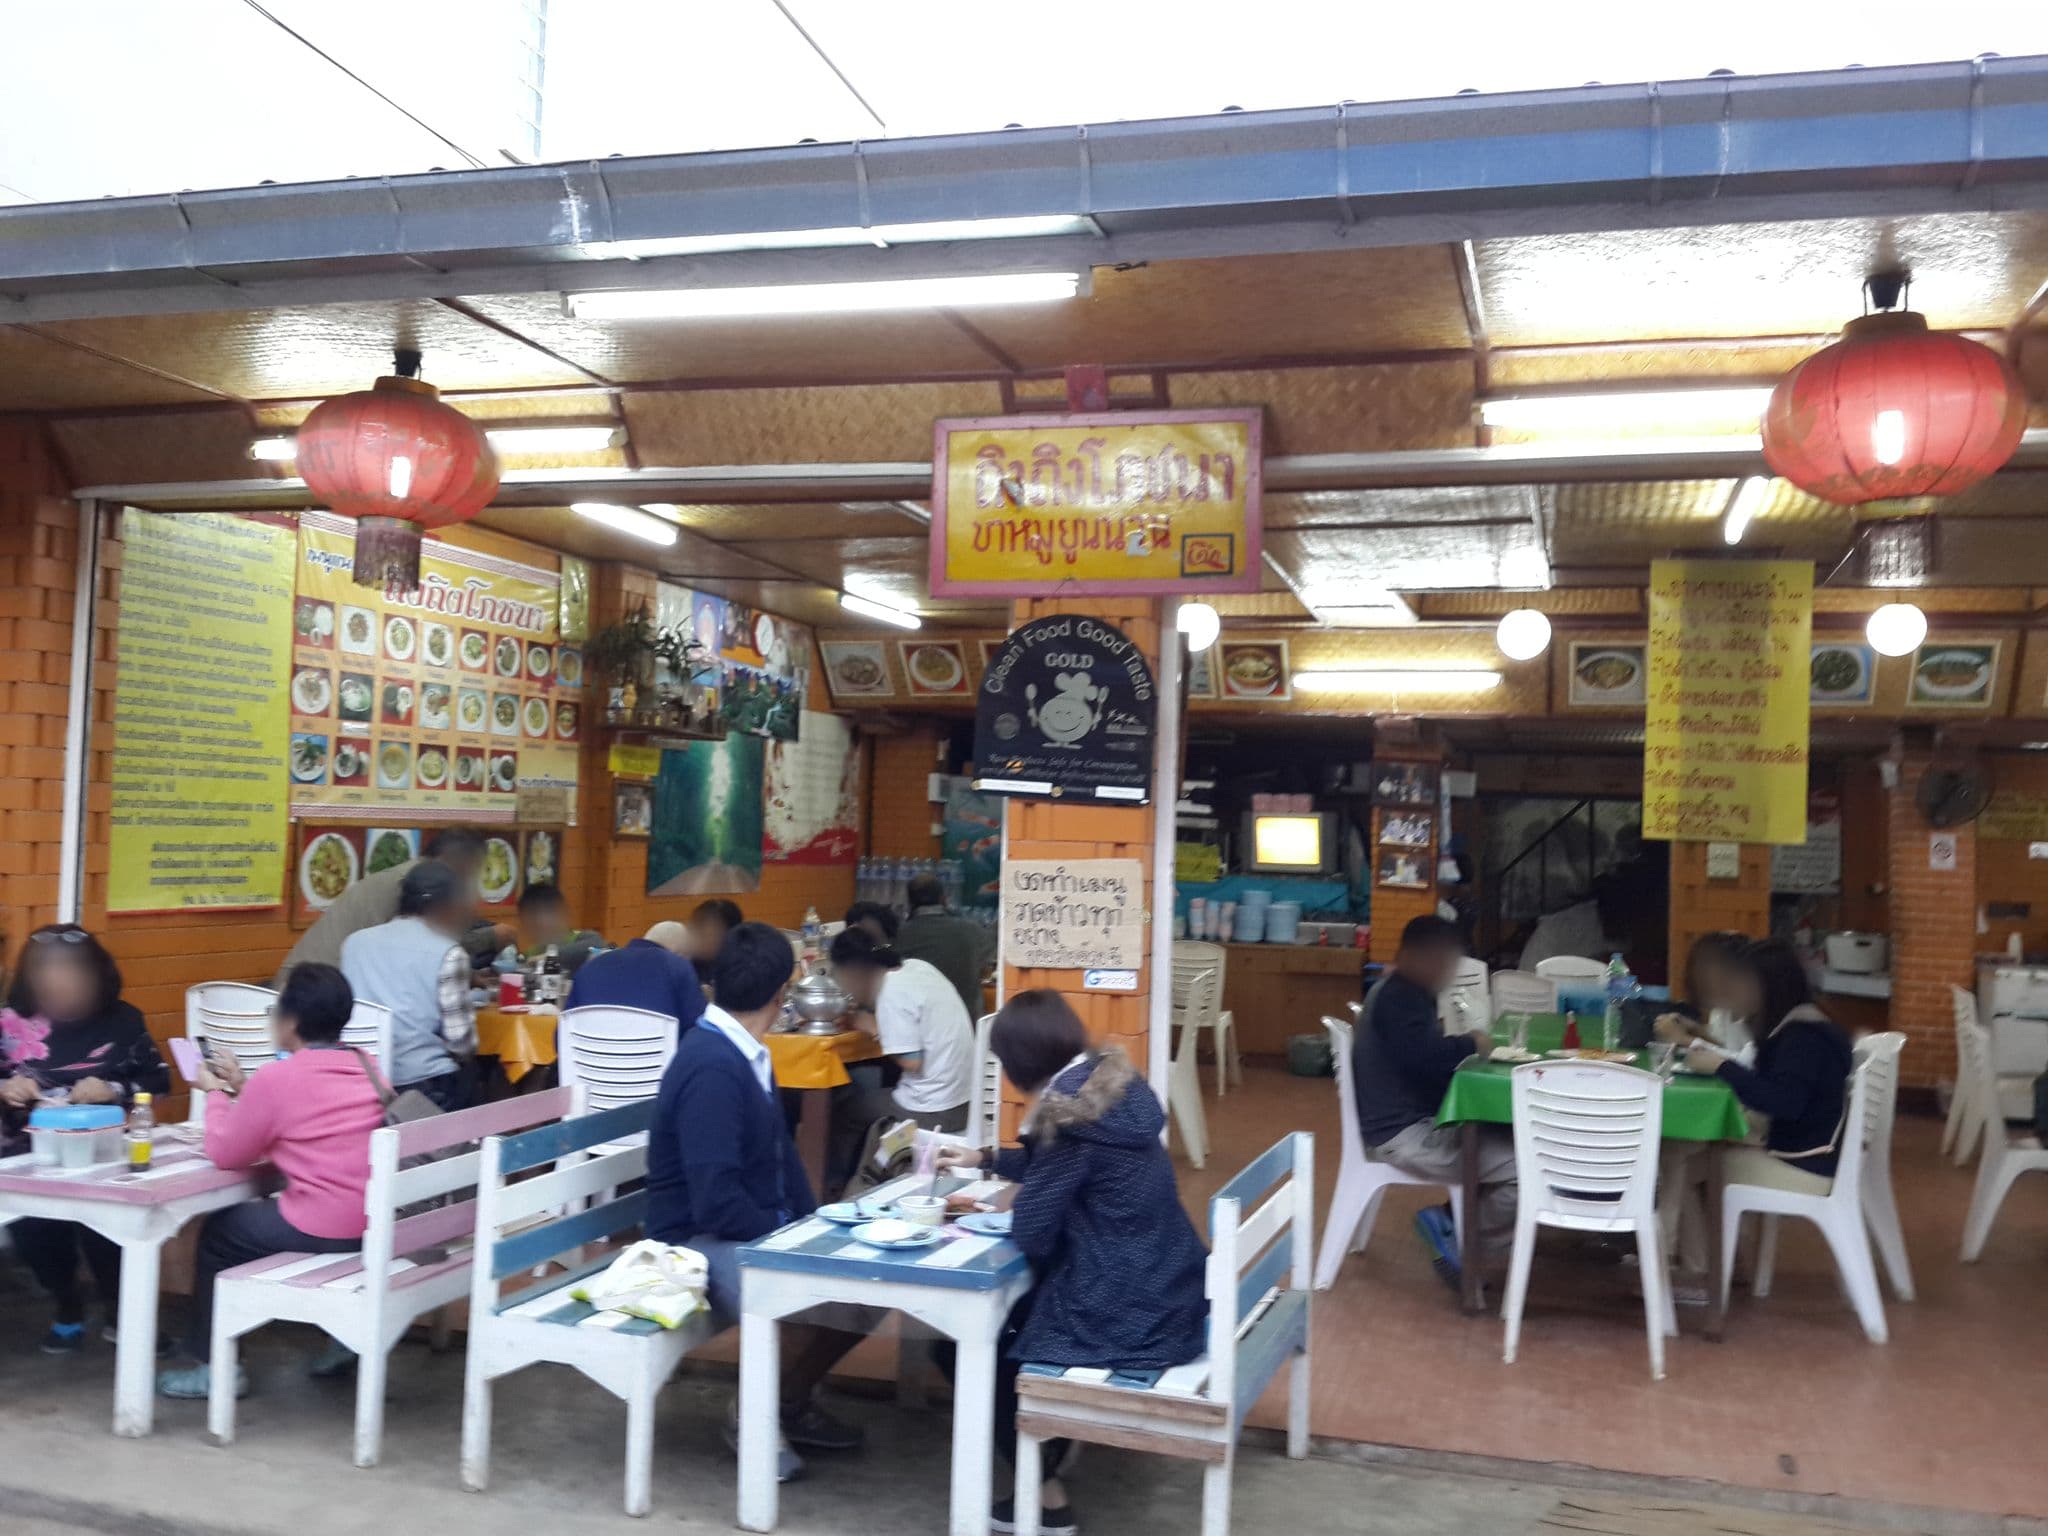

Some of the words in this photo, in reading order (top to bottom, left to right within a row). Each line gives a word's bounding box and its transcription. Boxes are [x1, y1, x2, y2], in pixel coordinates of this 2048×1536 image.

[985, 640, 1024, 693] Clean
[1021, 620, 1071, 648] Food
[1077, 620, 1128, 655] Good
[1123, 648, 1151, 701] Taste
[1045, 652, 1094, 668] GOLD
